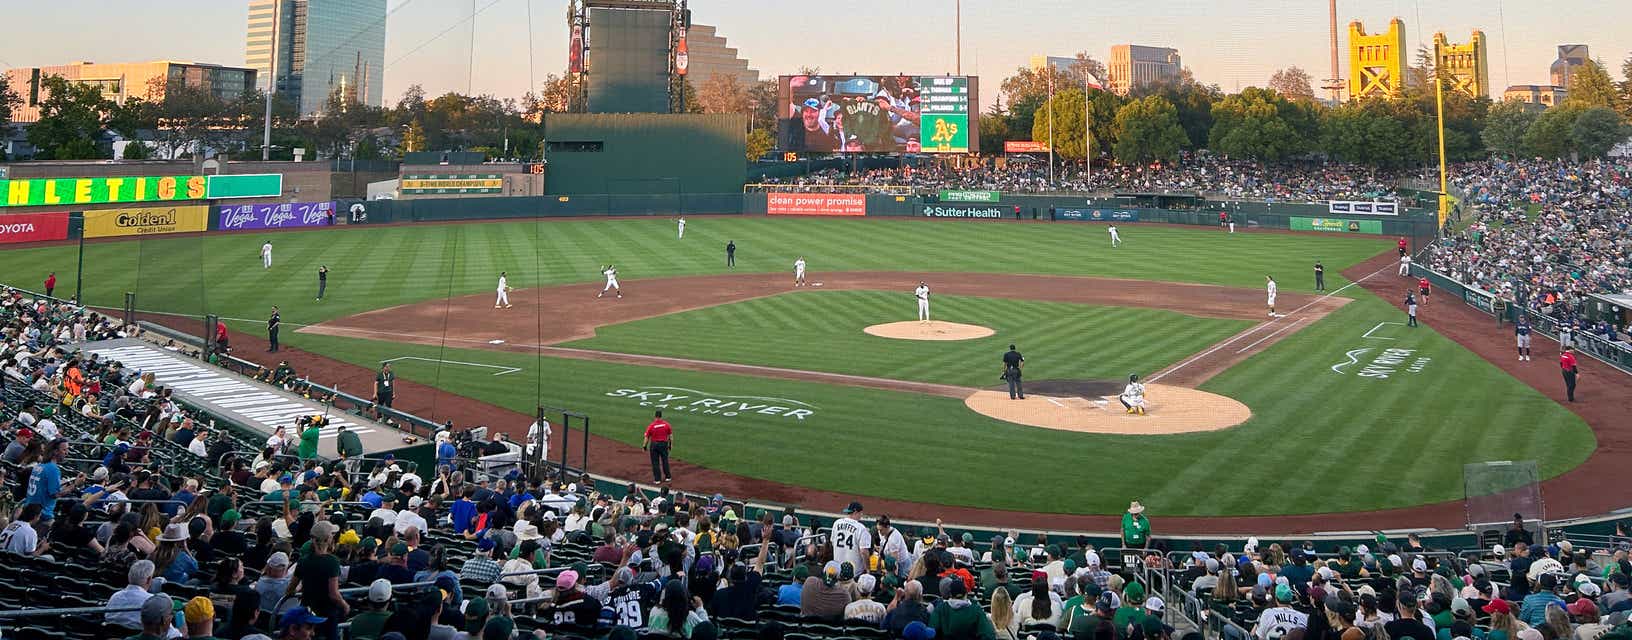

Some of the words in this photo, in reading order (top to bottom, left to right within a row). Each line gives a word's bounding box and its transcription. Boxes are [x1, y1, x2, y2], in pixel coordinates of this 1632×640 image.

[846, 101, 880, 117] GIANTS
[770, 196, 793, 205] clean
[796, 198, 824, 206] power
[827, 197, 863, 207] promise
[221, 208, 258, 228] Vegas
[261, 206, 296, 226] Vegas
[299, 205, 328, 224] Vega
[935, 207, 965, 217] Sutter
[967, 208, 1001, 217] Health
[605, 388, 688, 402] SKY
[691, 398, 813, 419] RIVER
[639, 401, 738, 416] CASINO
[837, 532, 853, 549] 24
[615, 602, 643, 626] 39
[1274, 612, 1299, 625] MILLS
